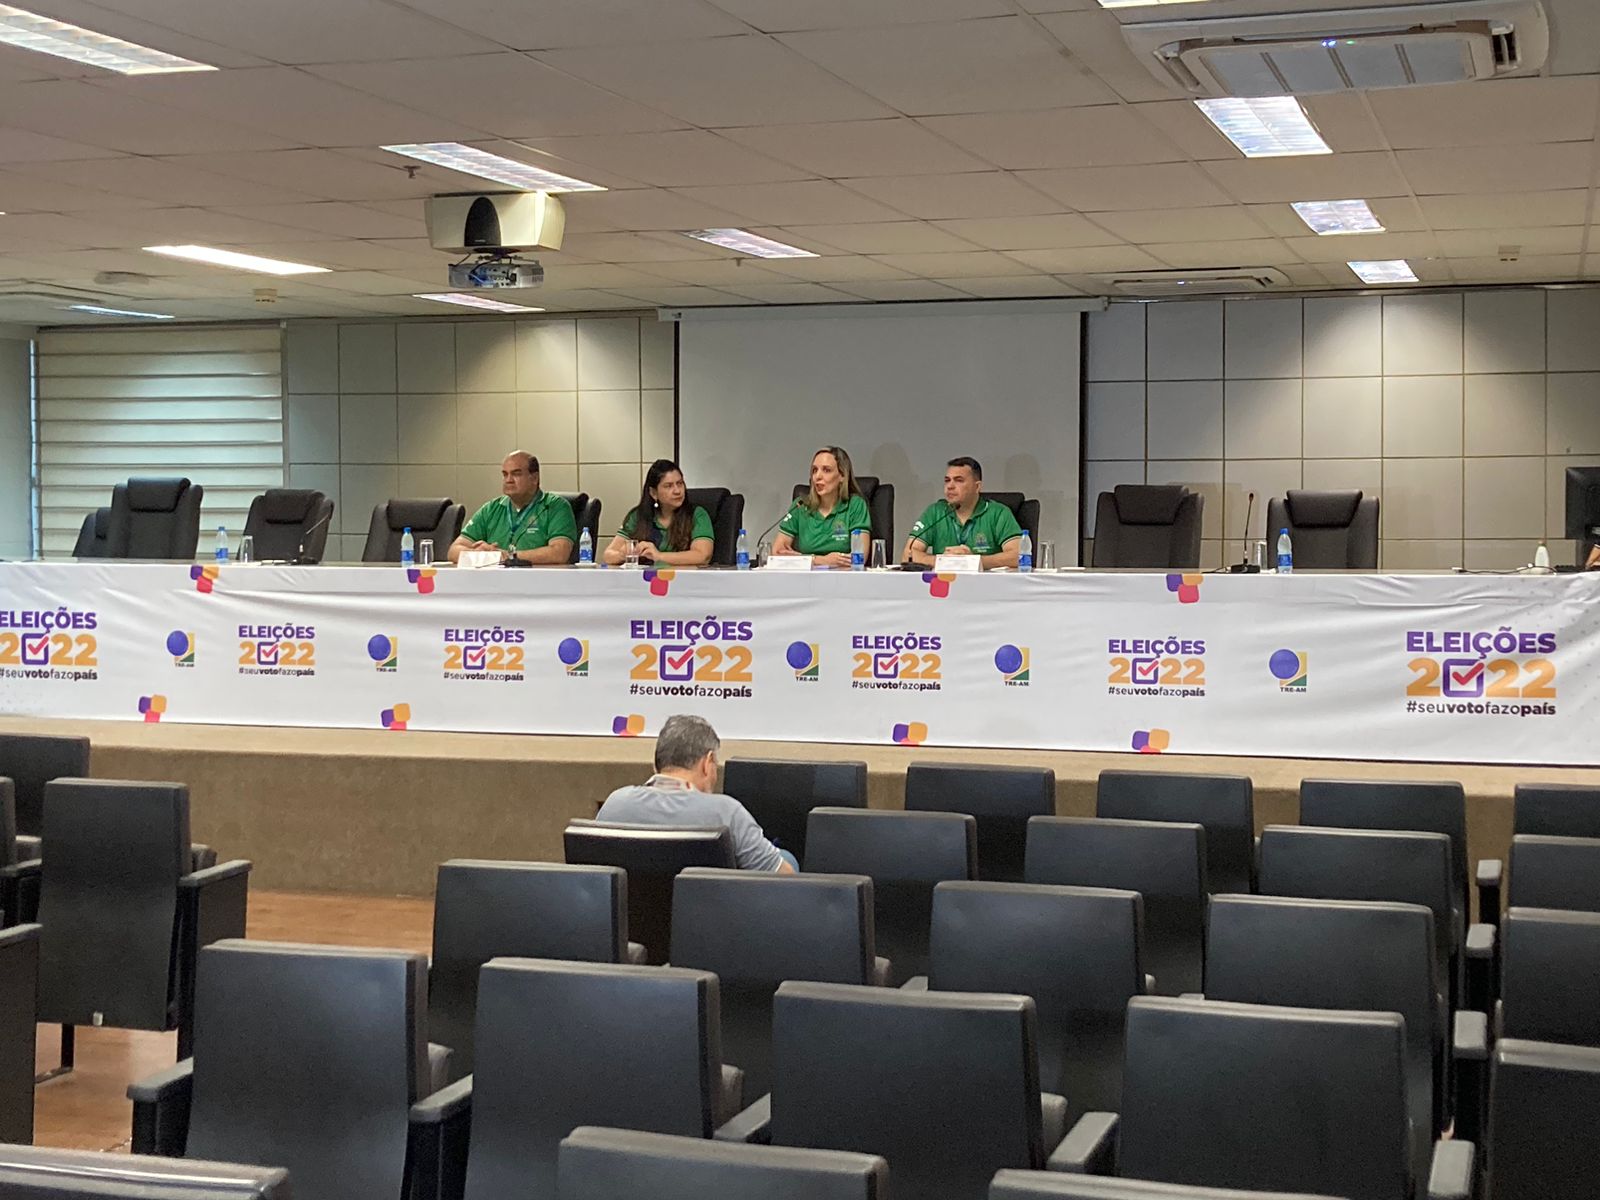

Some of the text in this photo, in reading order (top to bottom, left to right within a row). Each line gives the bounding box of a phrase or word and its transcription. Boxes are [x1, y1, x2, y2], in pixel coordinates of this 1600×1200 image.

[0, 606, 97, 634] ELEIÇÕES
[239, 623, 315, 643] ELEIÇÕES
[444, 626, 525, 647] ELEIÇÕES
[630, 616, 753, 646] ELEIÇÕES
[853, 632, 941, 653] ELEIÇÕES
[1108, 637, 1205, 658] ELEIÇÕES
[1407, 627, 1556, 659] ELEIÇÕES
[239, 667, 315, 676] #seuvotofazopaís
[444, 672, 524, 681] #seuvotofazopaís
[630, 684, 752, 699] #seuvotofazopaís
[852, 680, 941, 691] #seuvotofazopaís
[1108, 686, 1205, 697] #seuvotofazopaís
[1407, 700, 1556, 717] #seuvotofazopaís
